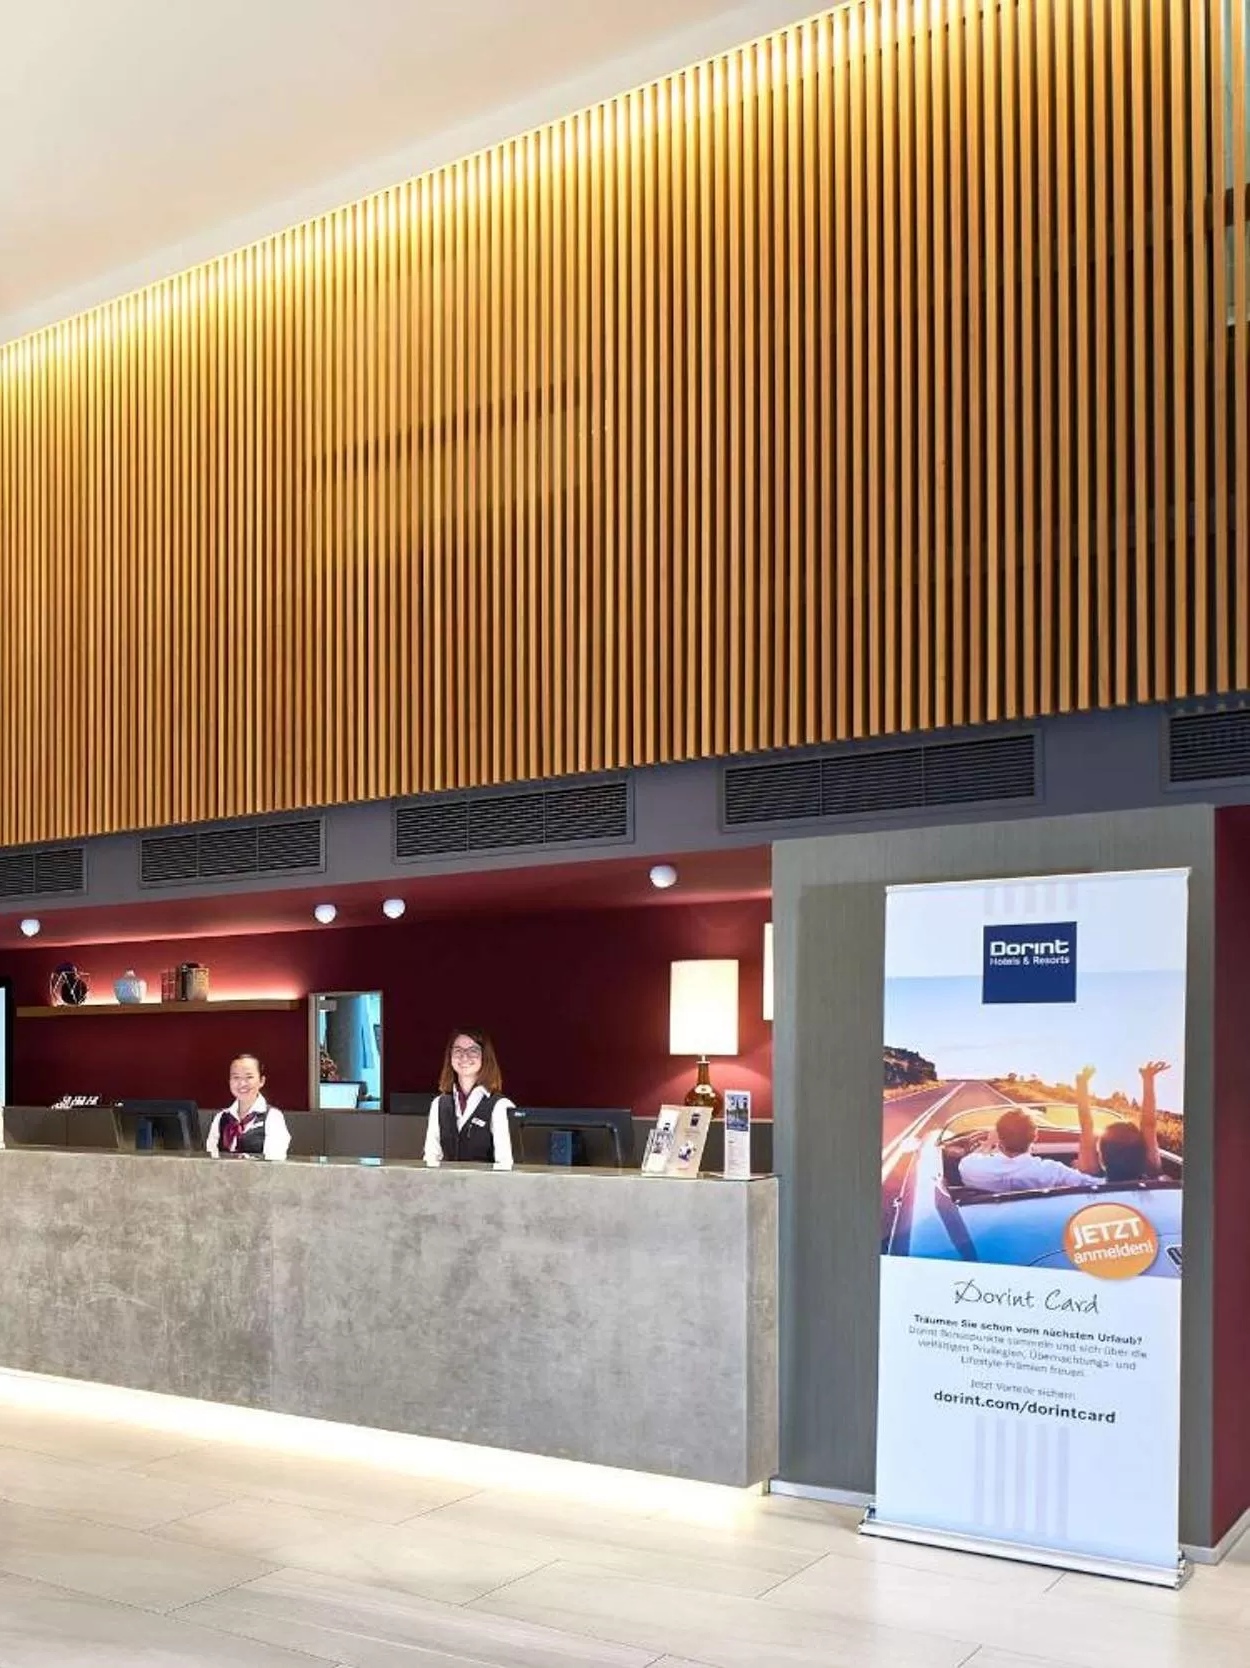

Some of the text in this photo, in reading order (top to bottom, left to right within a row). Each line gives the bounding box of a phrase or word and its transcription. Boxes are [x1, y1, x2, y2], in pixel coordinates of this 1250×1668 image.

[990, 939, 1070, 956] Dorint
[990, 955, 1070, 966] Hotels & Resorts
[1073, 1217, 1141, 1249] JETZT
[1073, 1240, 1154, 1264] anmelden!
[954, 1279, 1099, 1314] Dorint Card
[961, 1319, 977, 1329] Sie
[1016, 1326, 1039, 1335] vom
[1098, 1333, 1142, 1345] Urlaub?
[934, 1391, 1117, 1424] dorint.com/dorintcard
